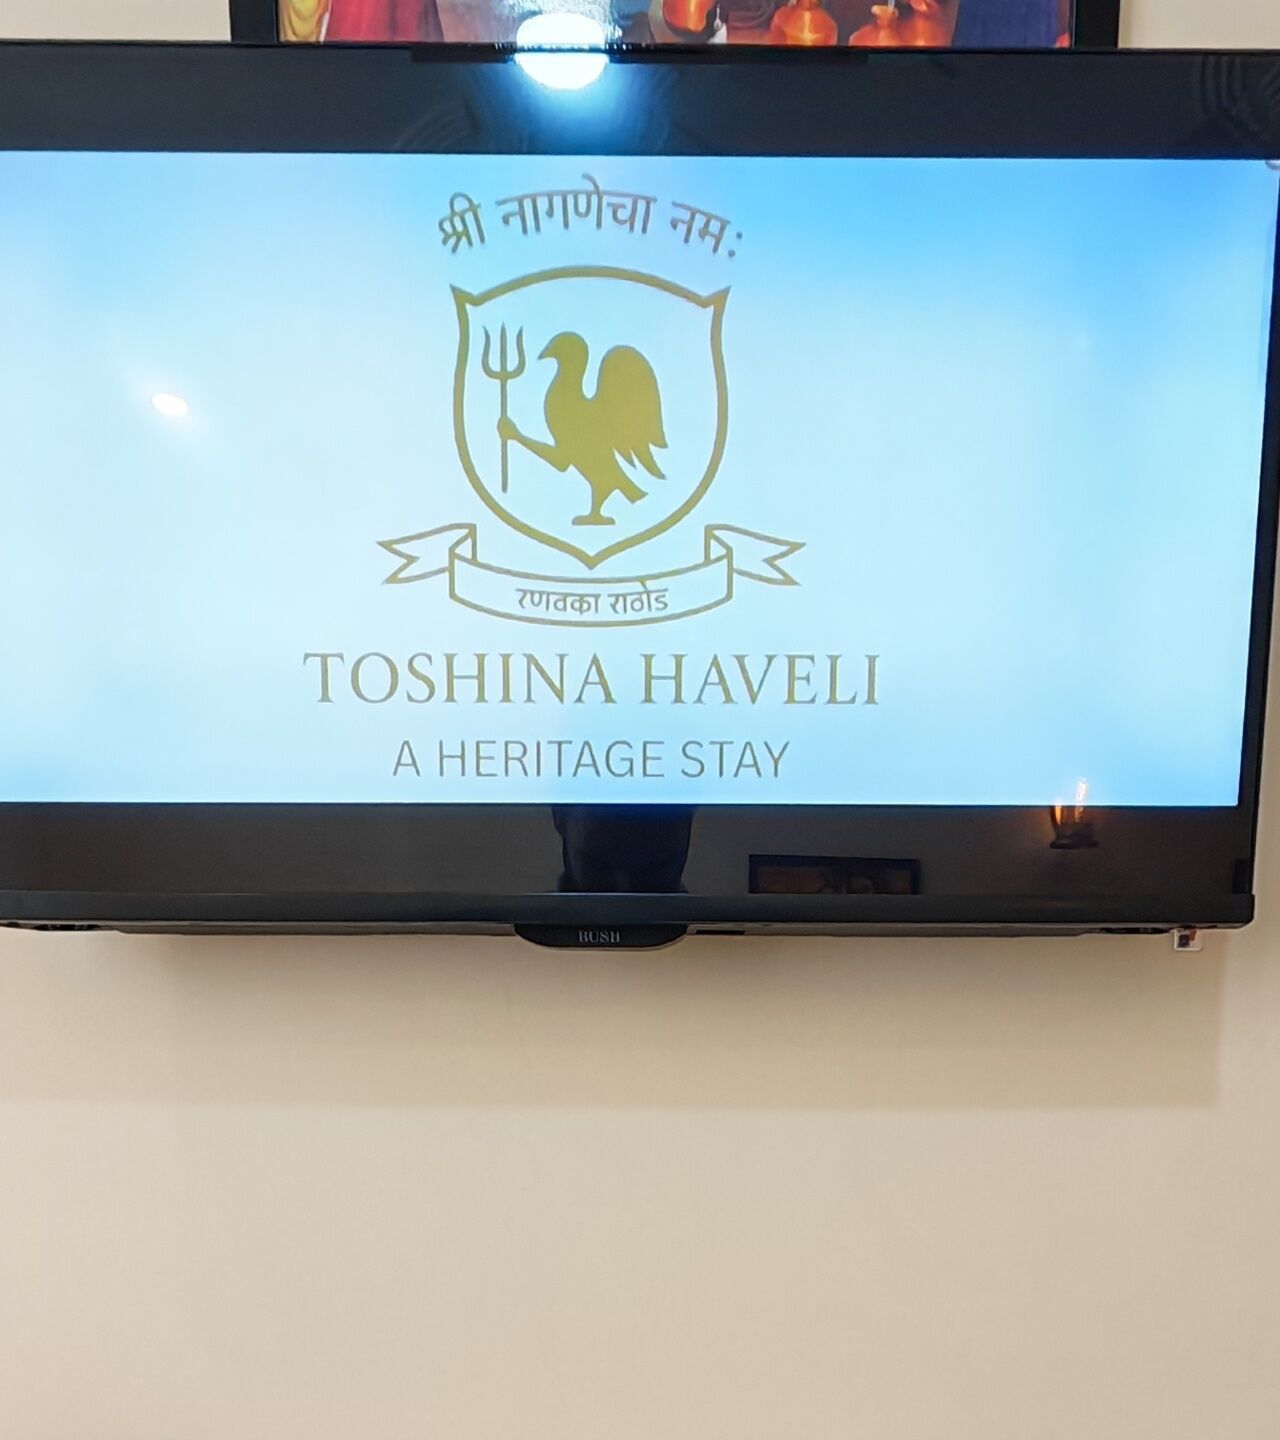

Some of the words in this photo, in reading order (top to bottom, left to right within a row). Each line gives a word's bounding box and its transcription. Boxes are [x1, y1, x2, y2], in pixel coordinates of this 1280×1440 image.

[438, 192, 486, 254] श्री
[495, 173, 658, 235] नागणेचा
[303, 652, 617, 705] TOSHINA
[640, 653, 879, 705] HAVELI
[392, 740, 421, 777] A
[438, 739, 665, 778] HERITAGE
[680, 740, 790, 778] STAY
[578, 929, 620, 944] BUSH
